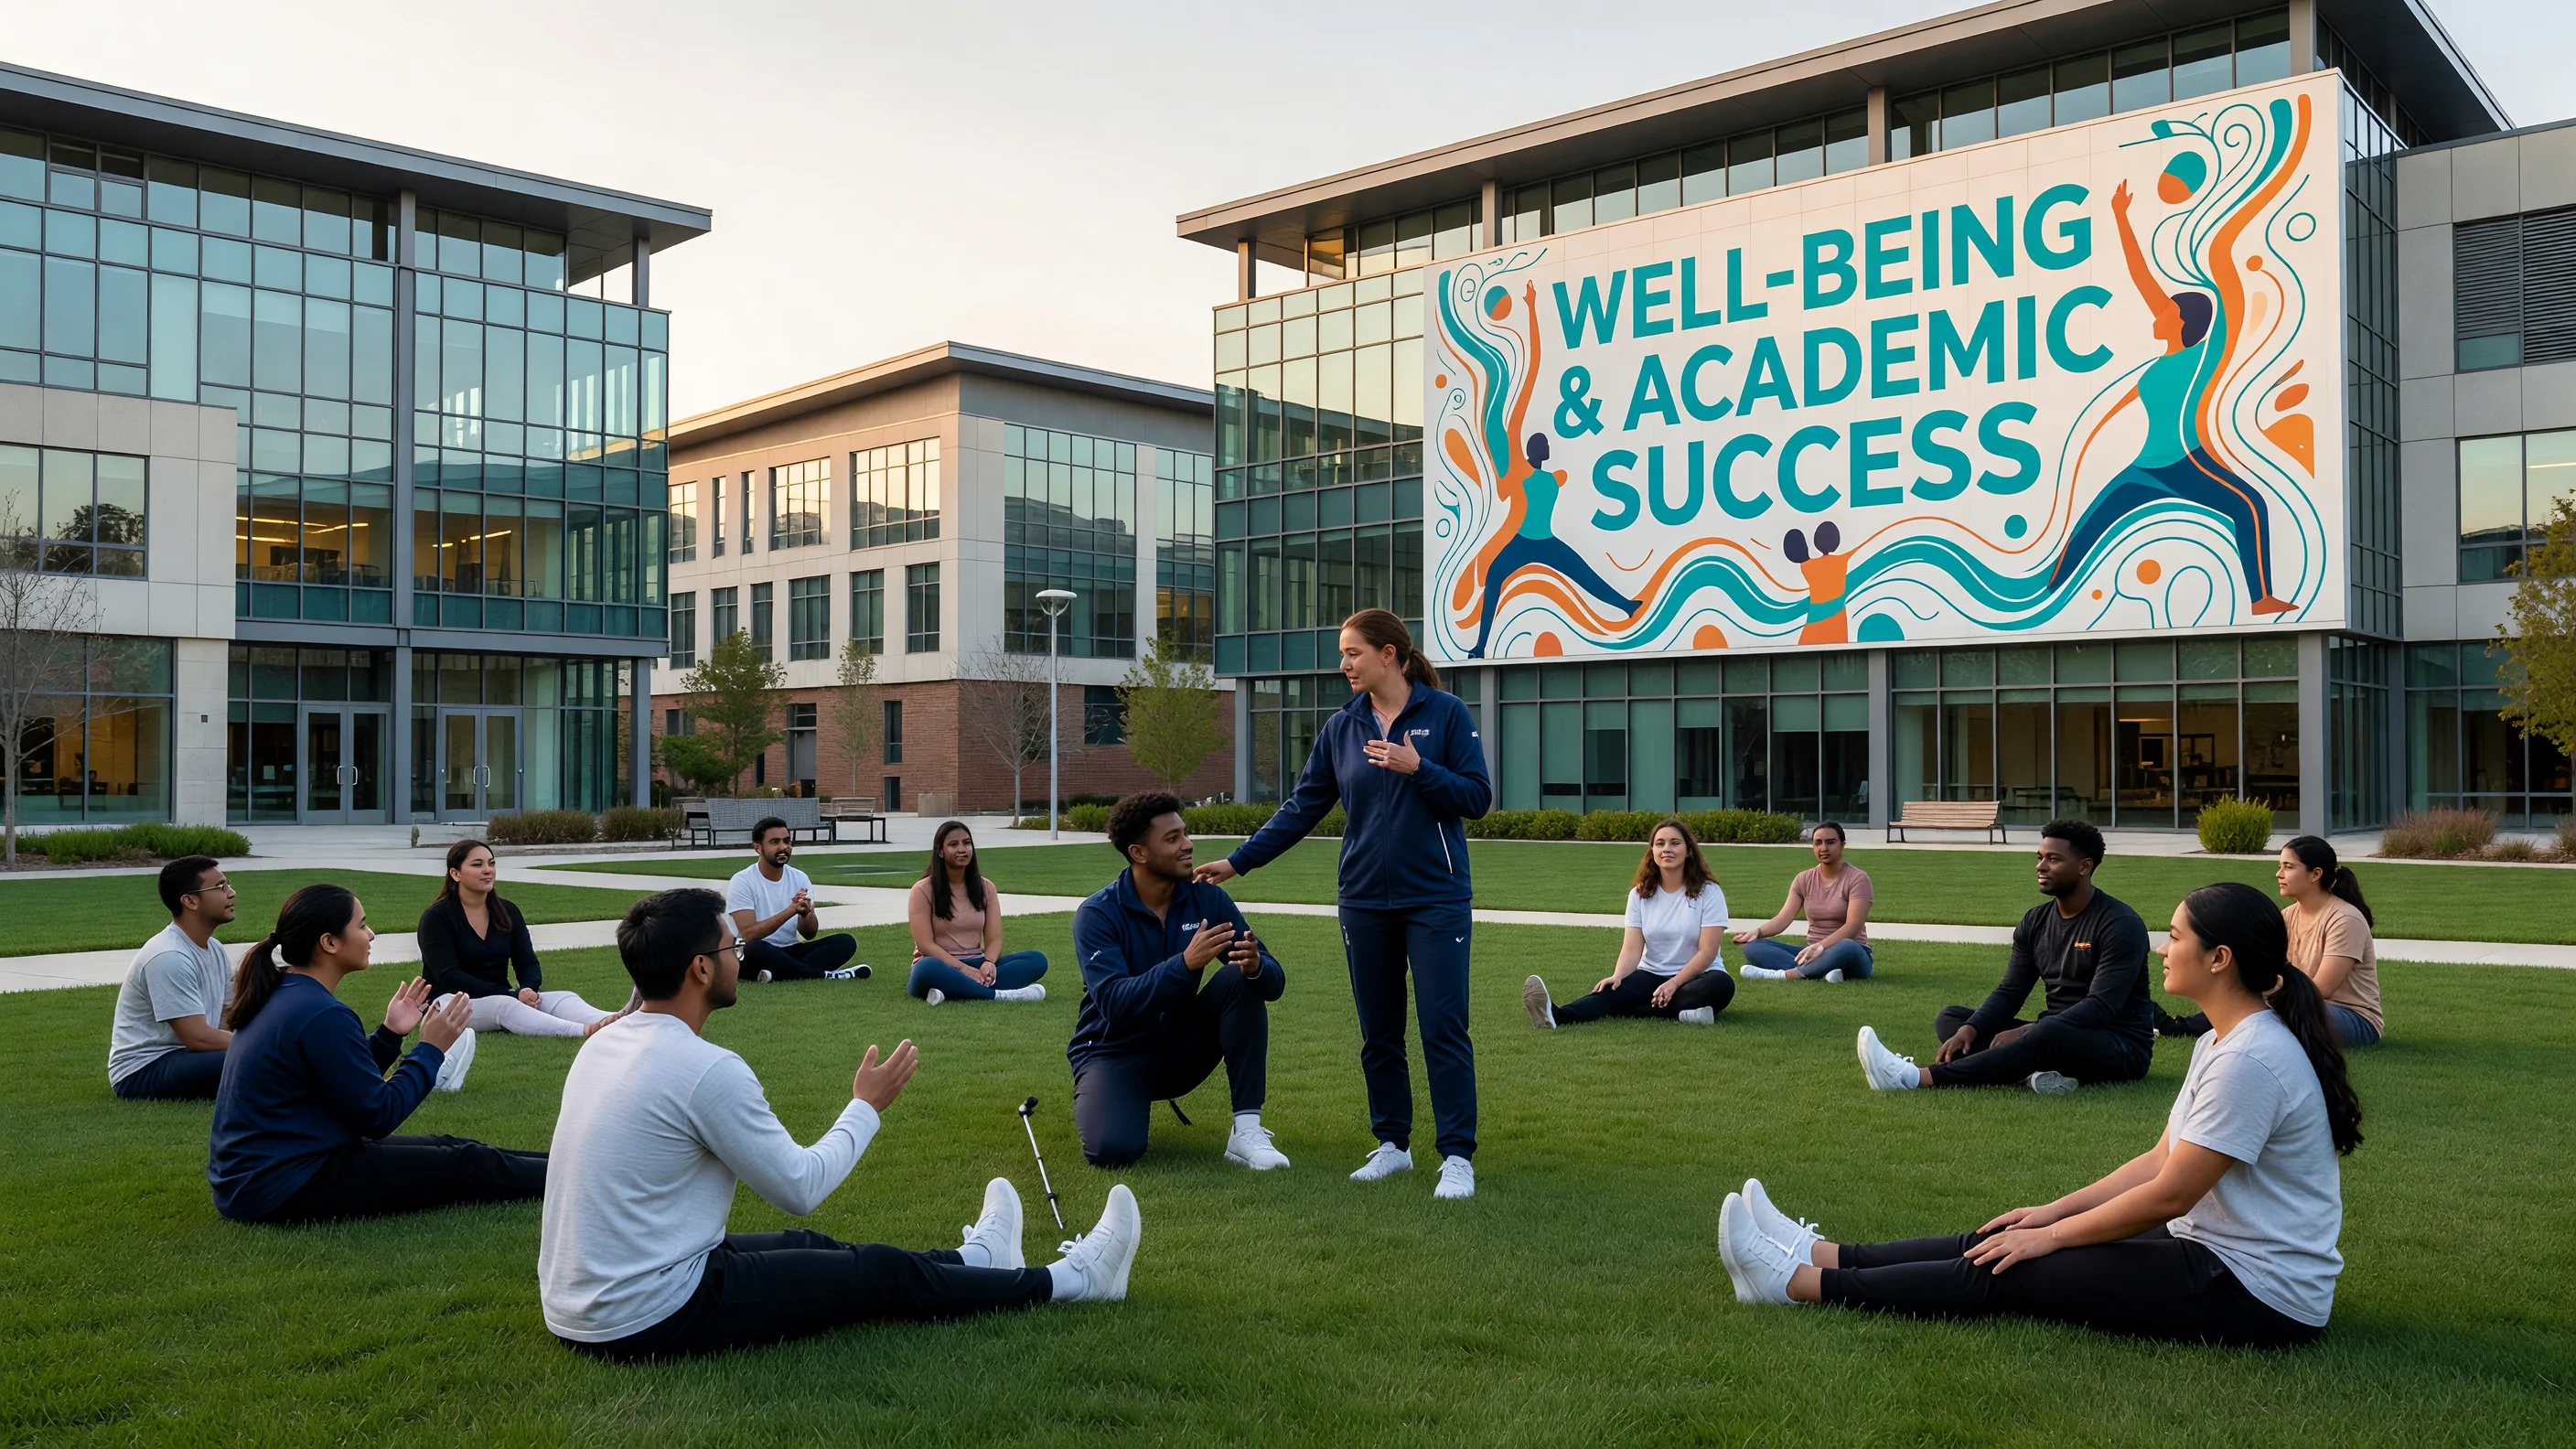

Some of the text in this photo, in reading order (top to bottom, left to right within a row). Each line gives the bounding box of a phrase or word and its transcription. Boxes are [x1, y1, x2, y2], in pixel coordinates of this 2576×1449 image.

[1552, 183, 2092, 350] WELL-BEING
[1552, 284, 2114, 439] & ACADEMIC
[1590, 401, 2042, 532] SUCCESS
